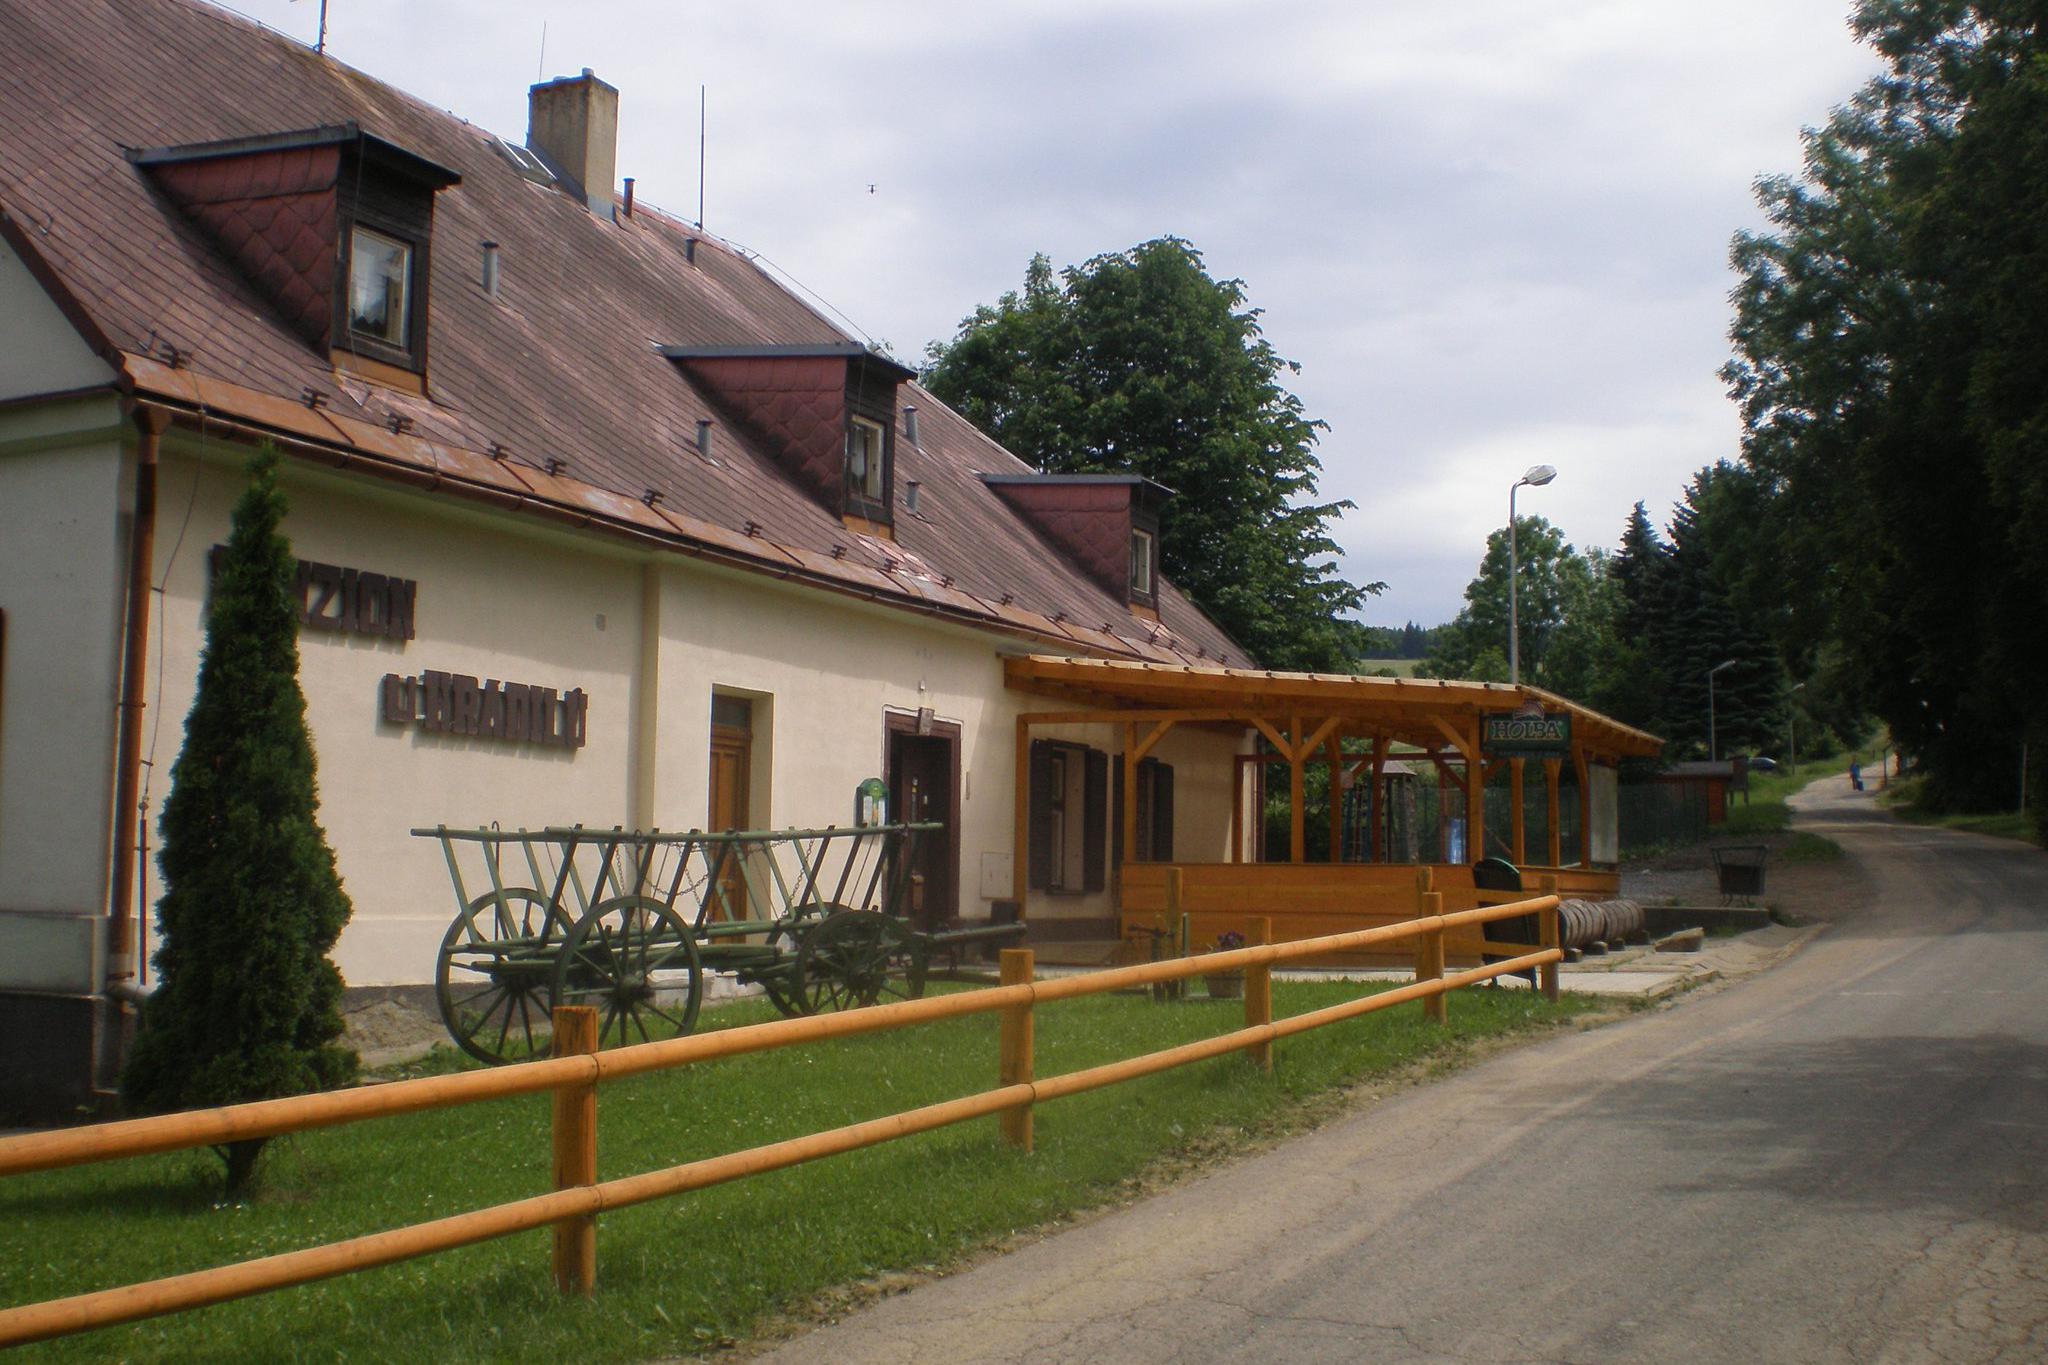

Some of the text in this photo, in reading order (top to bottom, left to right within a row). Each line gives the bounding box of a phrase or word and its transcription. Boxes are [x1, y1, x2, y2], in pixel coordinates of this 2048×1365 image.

[210, 544, 417, 641] ZION
[384, 673, 417, 721] U
[1492, 720, 1563, 740] HOLBA
